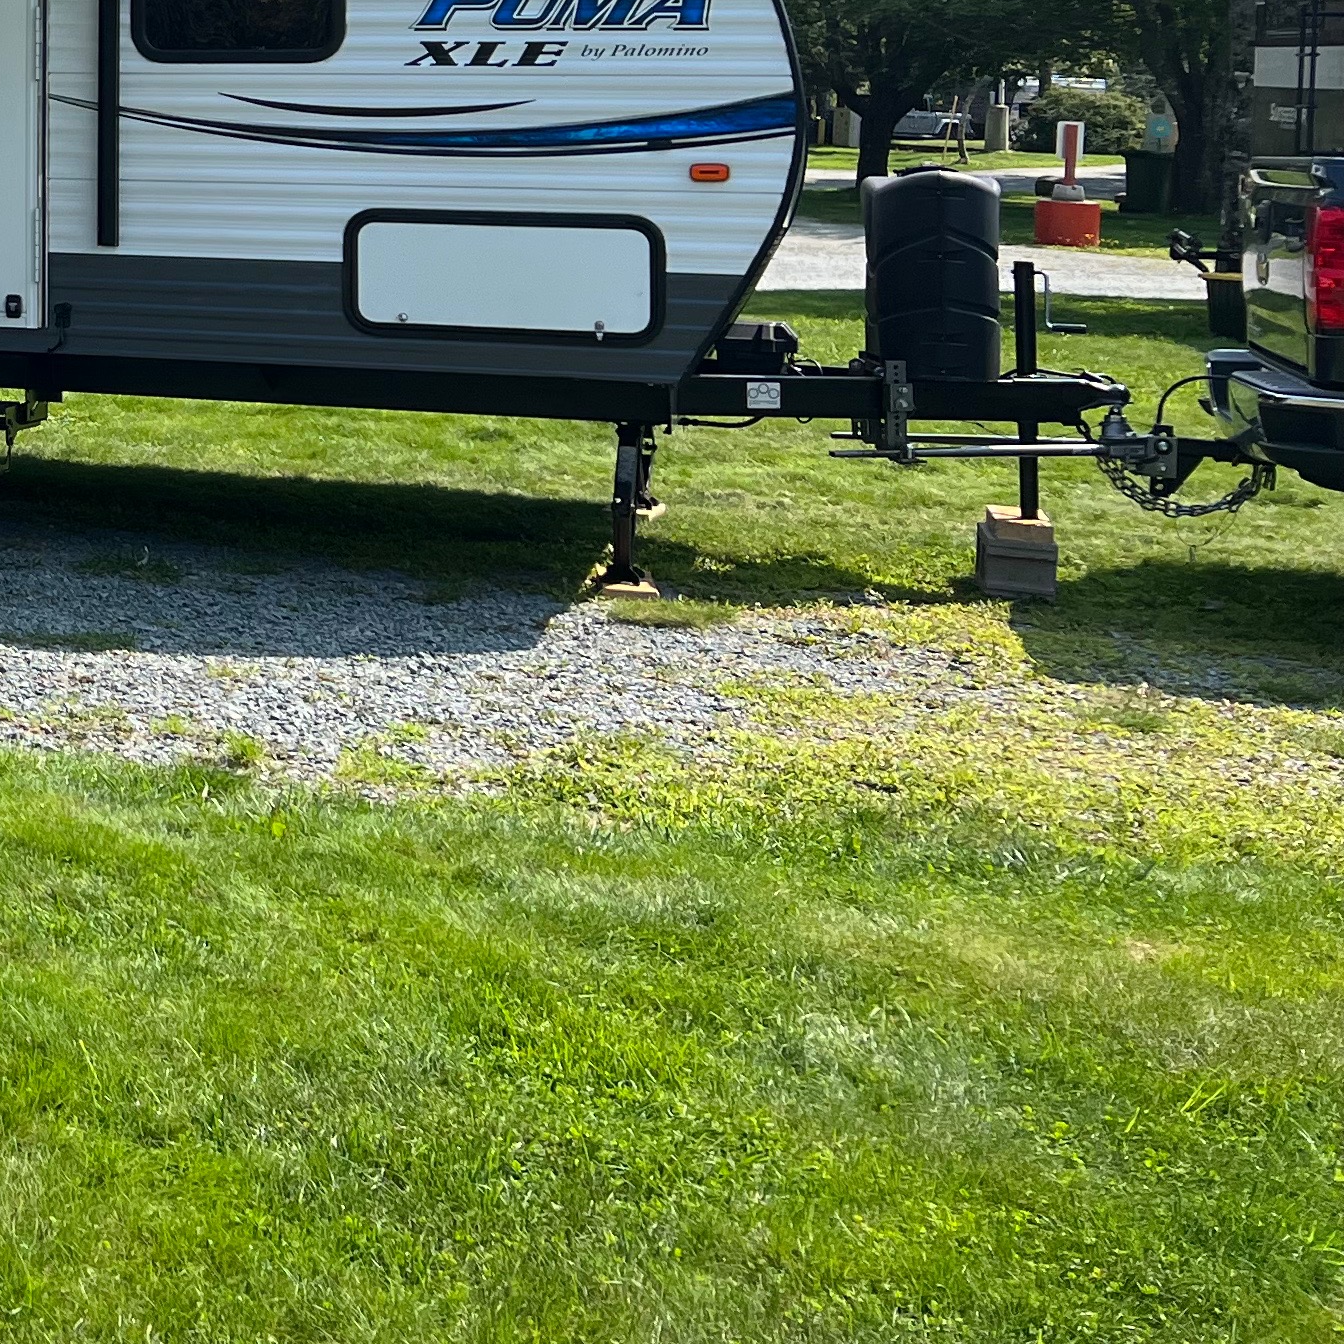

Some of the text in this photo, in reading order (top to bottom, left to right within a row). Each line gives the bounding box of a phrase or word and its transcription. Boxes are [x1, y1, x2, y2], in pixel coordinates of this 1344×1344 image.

[404, 40, 710, 68] XLE by Palomino
